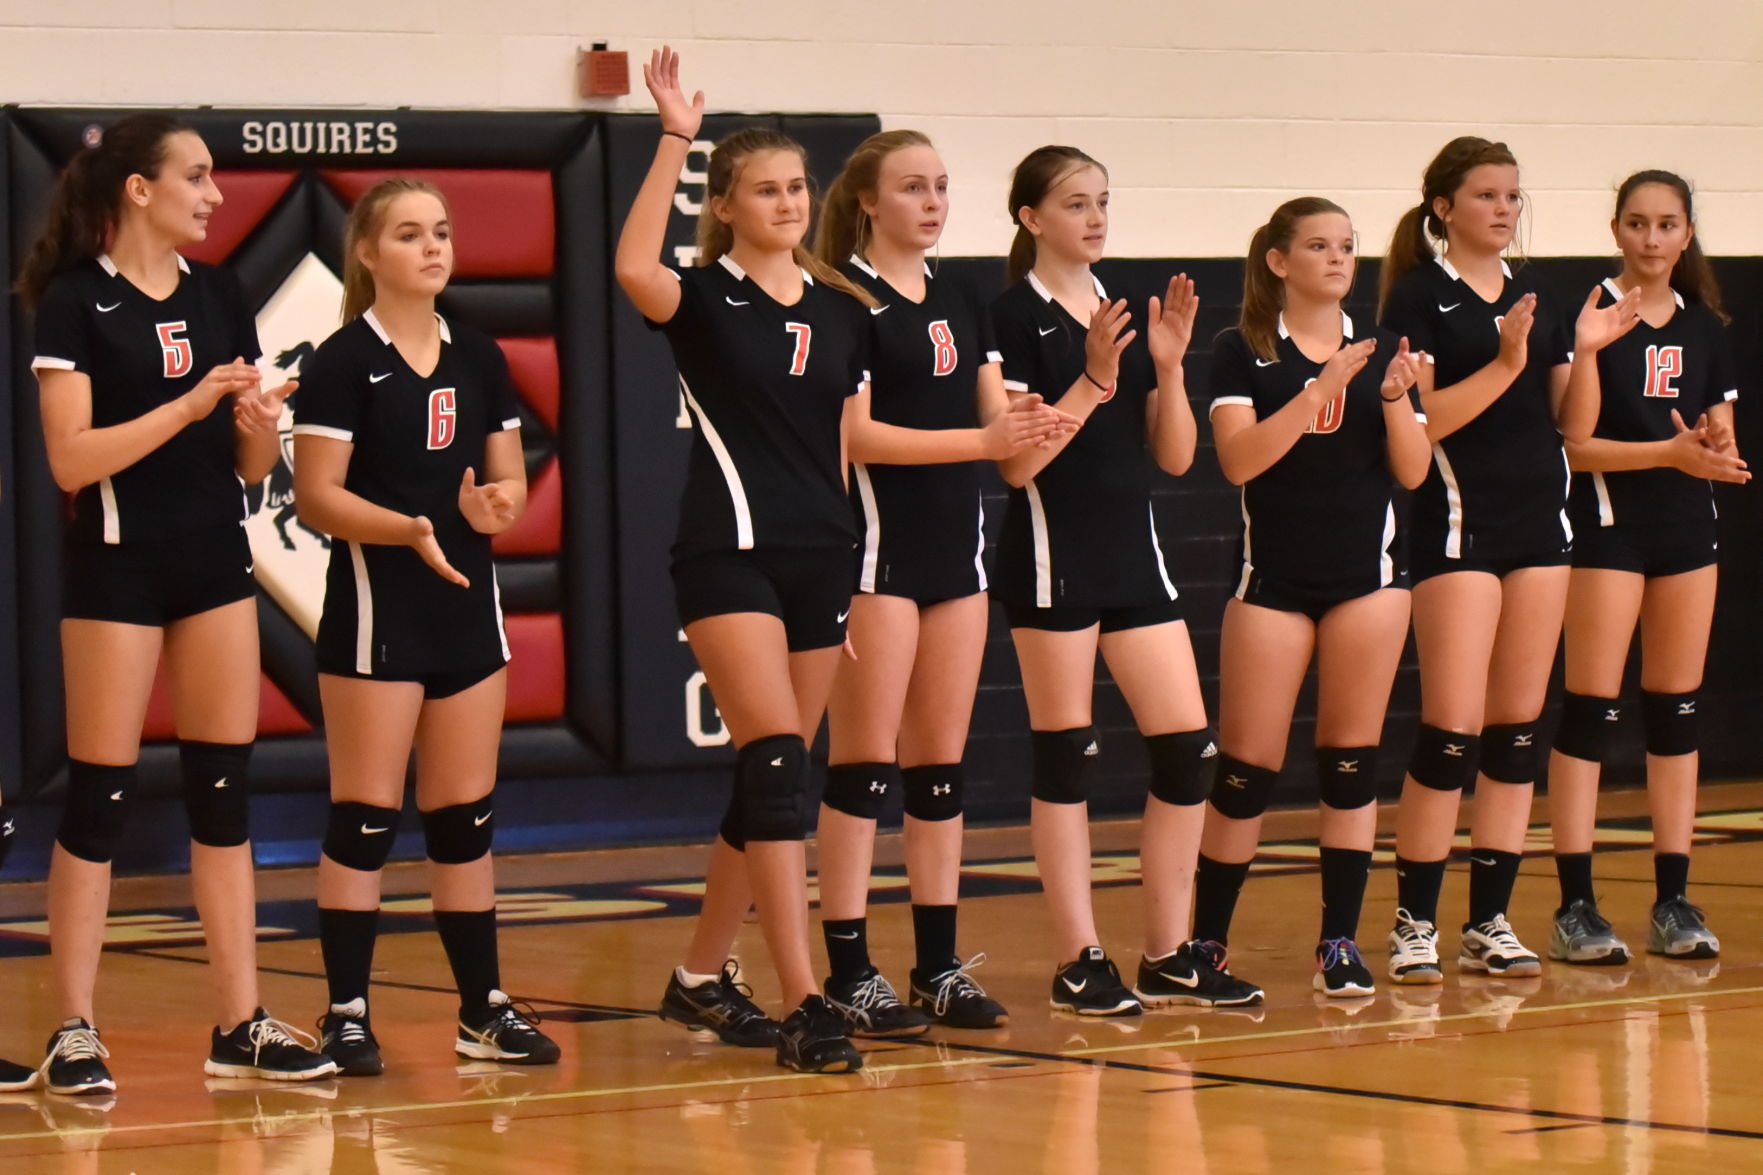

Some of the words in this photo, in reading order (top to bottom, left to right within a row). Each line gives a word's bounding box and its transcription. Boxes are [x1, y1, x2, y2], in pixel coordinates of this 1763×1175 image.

[242, 121, 398, 154] SQUIRES
[155, 320, 193, 378] 5
[785, 321, 812, 376] 7
[928, 320, 958, 376] 8
[1643, 344, 1683, 398] 12
[426, 387, 457, 450] 6
[1304, 377, 1347, 434] 0
